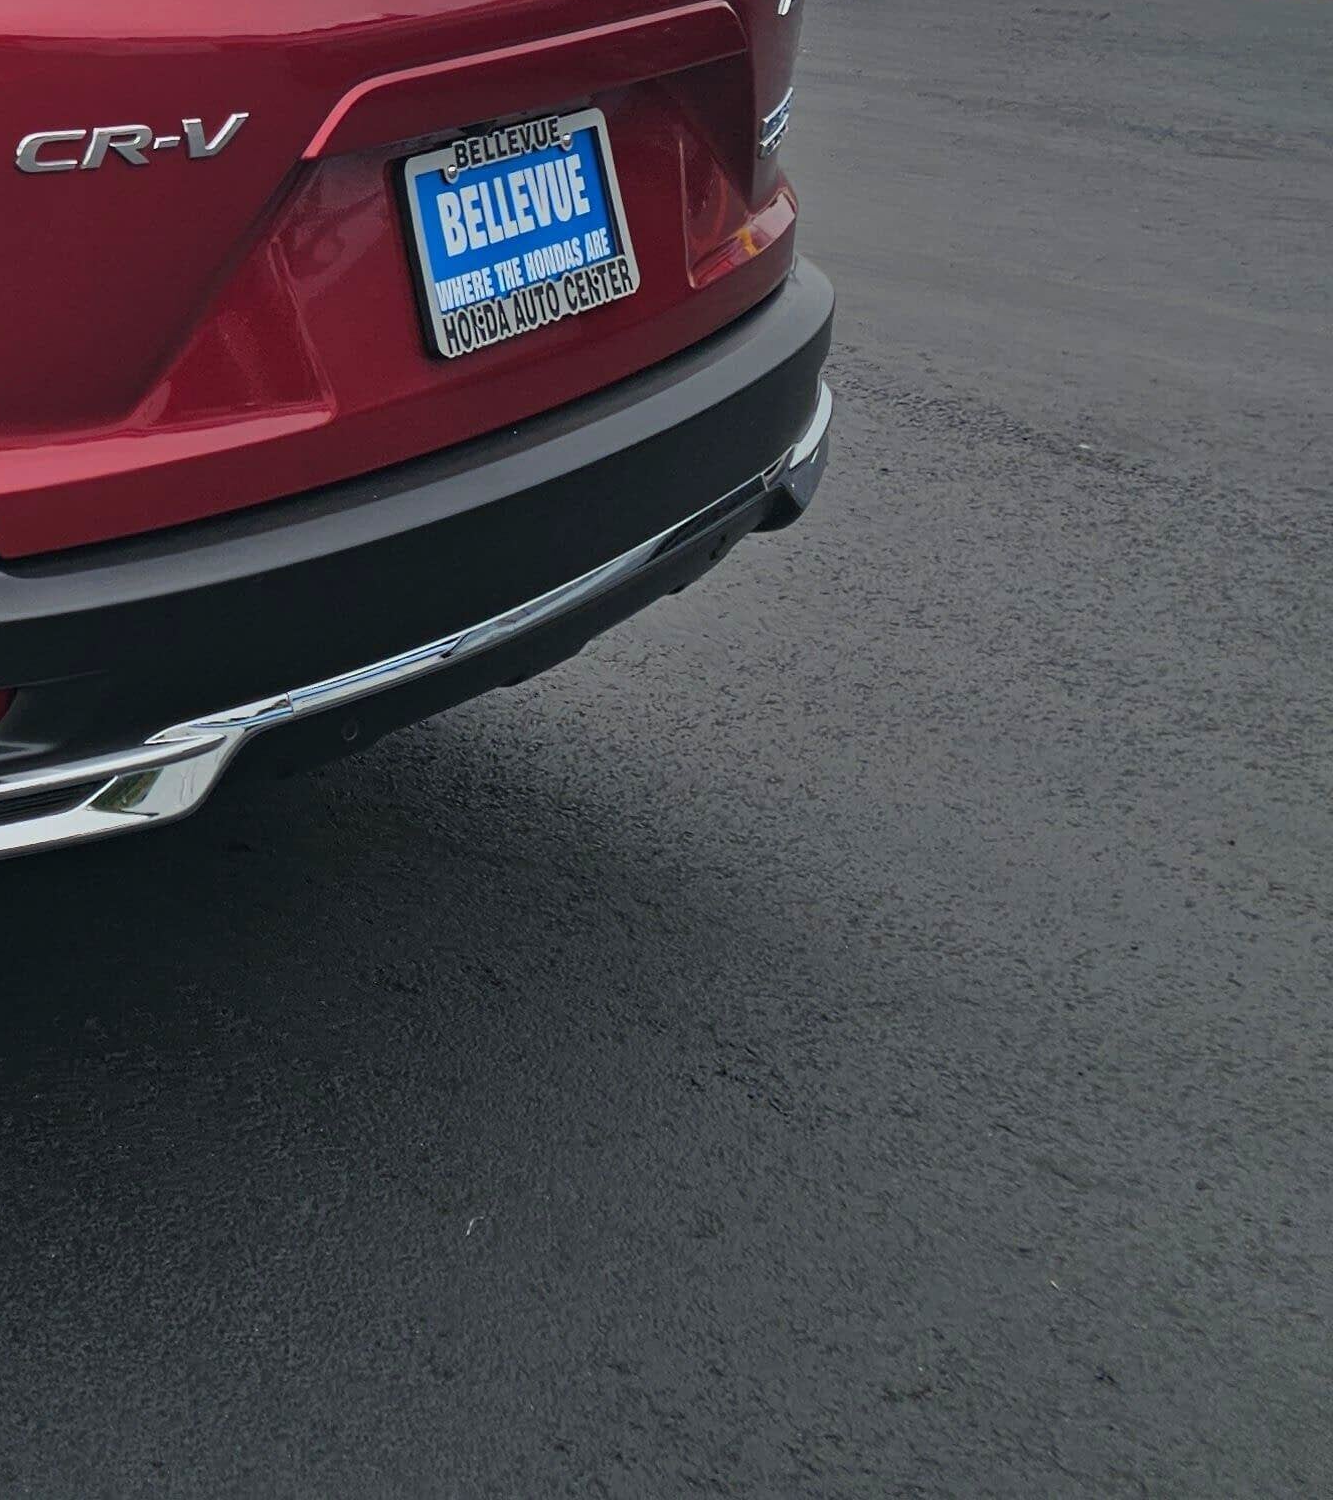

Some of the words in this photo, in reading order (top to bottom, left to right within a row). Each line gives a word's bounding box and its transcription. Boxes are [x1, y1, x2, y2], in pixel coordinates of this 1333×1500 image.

[16, 112, 250, 173] CR-V
[454, 117, 560, 169] BELLEVUE
[436, 154, 591, 257] BELLEVUE
[436, 267, 495, 312] WHERE
[495, 257, 524, 293] THE
[524, 239, 583, 279] HONDAS
[585, 227, 611, 262] ARE
[442, 301, 512, 355] HONDA
[513, 283, 560, 334] AUTO
[566, 260, 634, 312] CENTER
